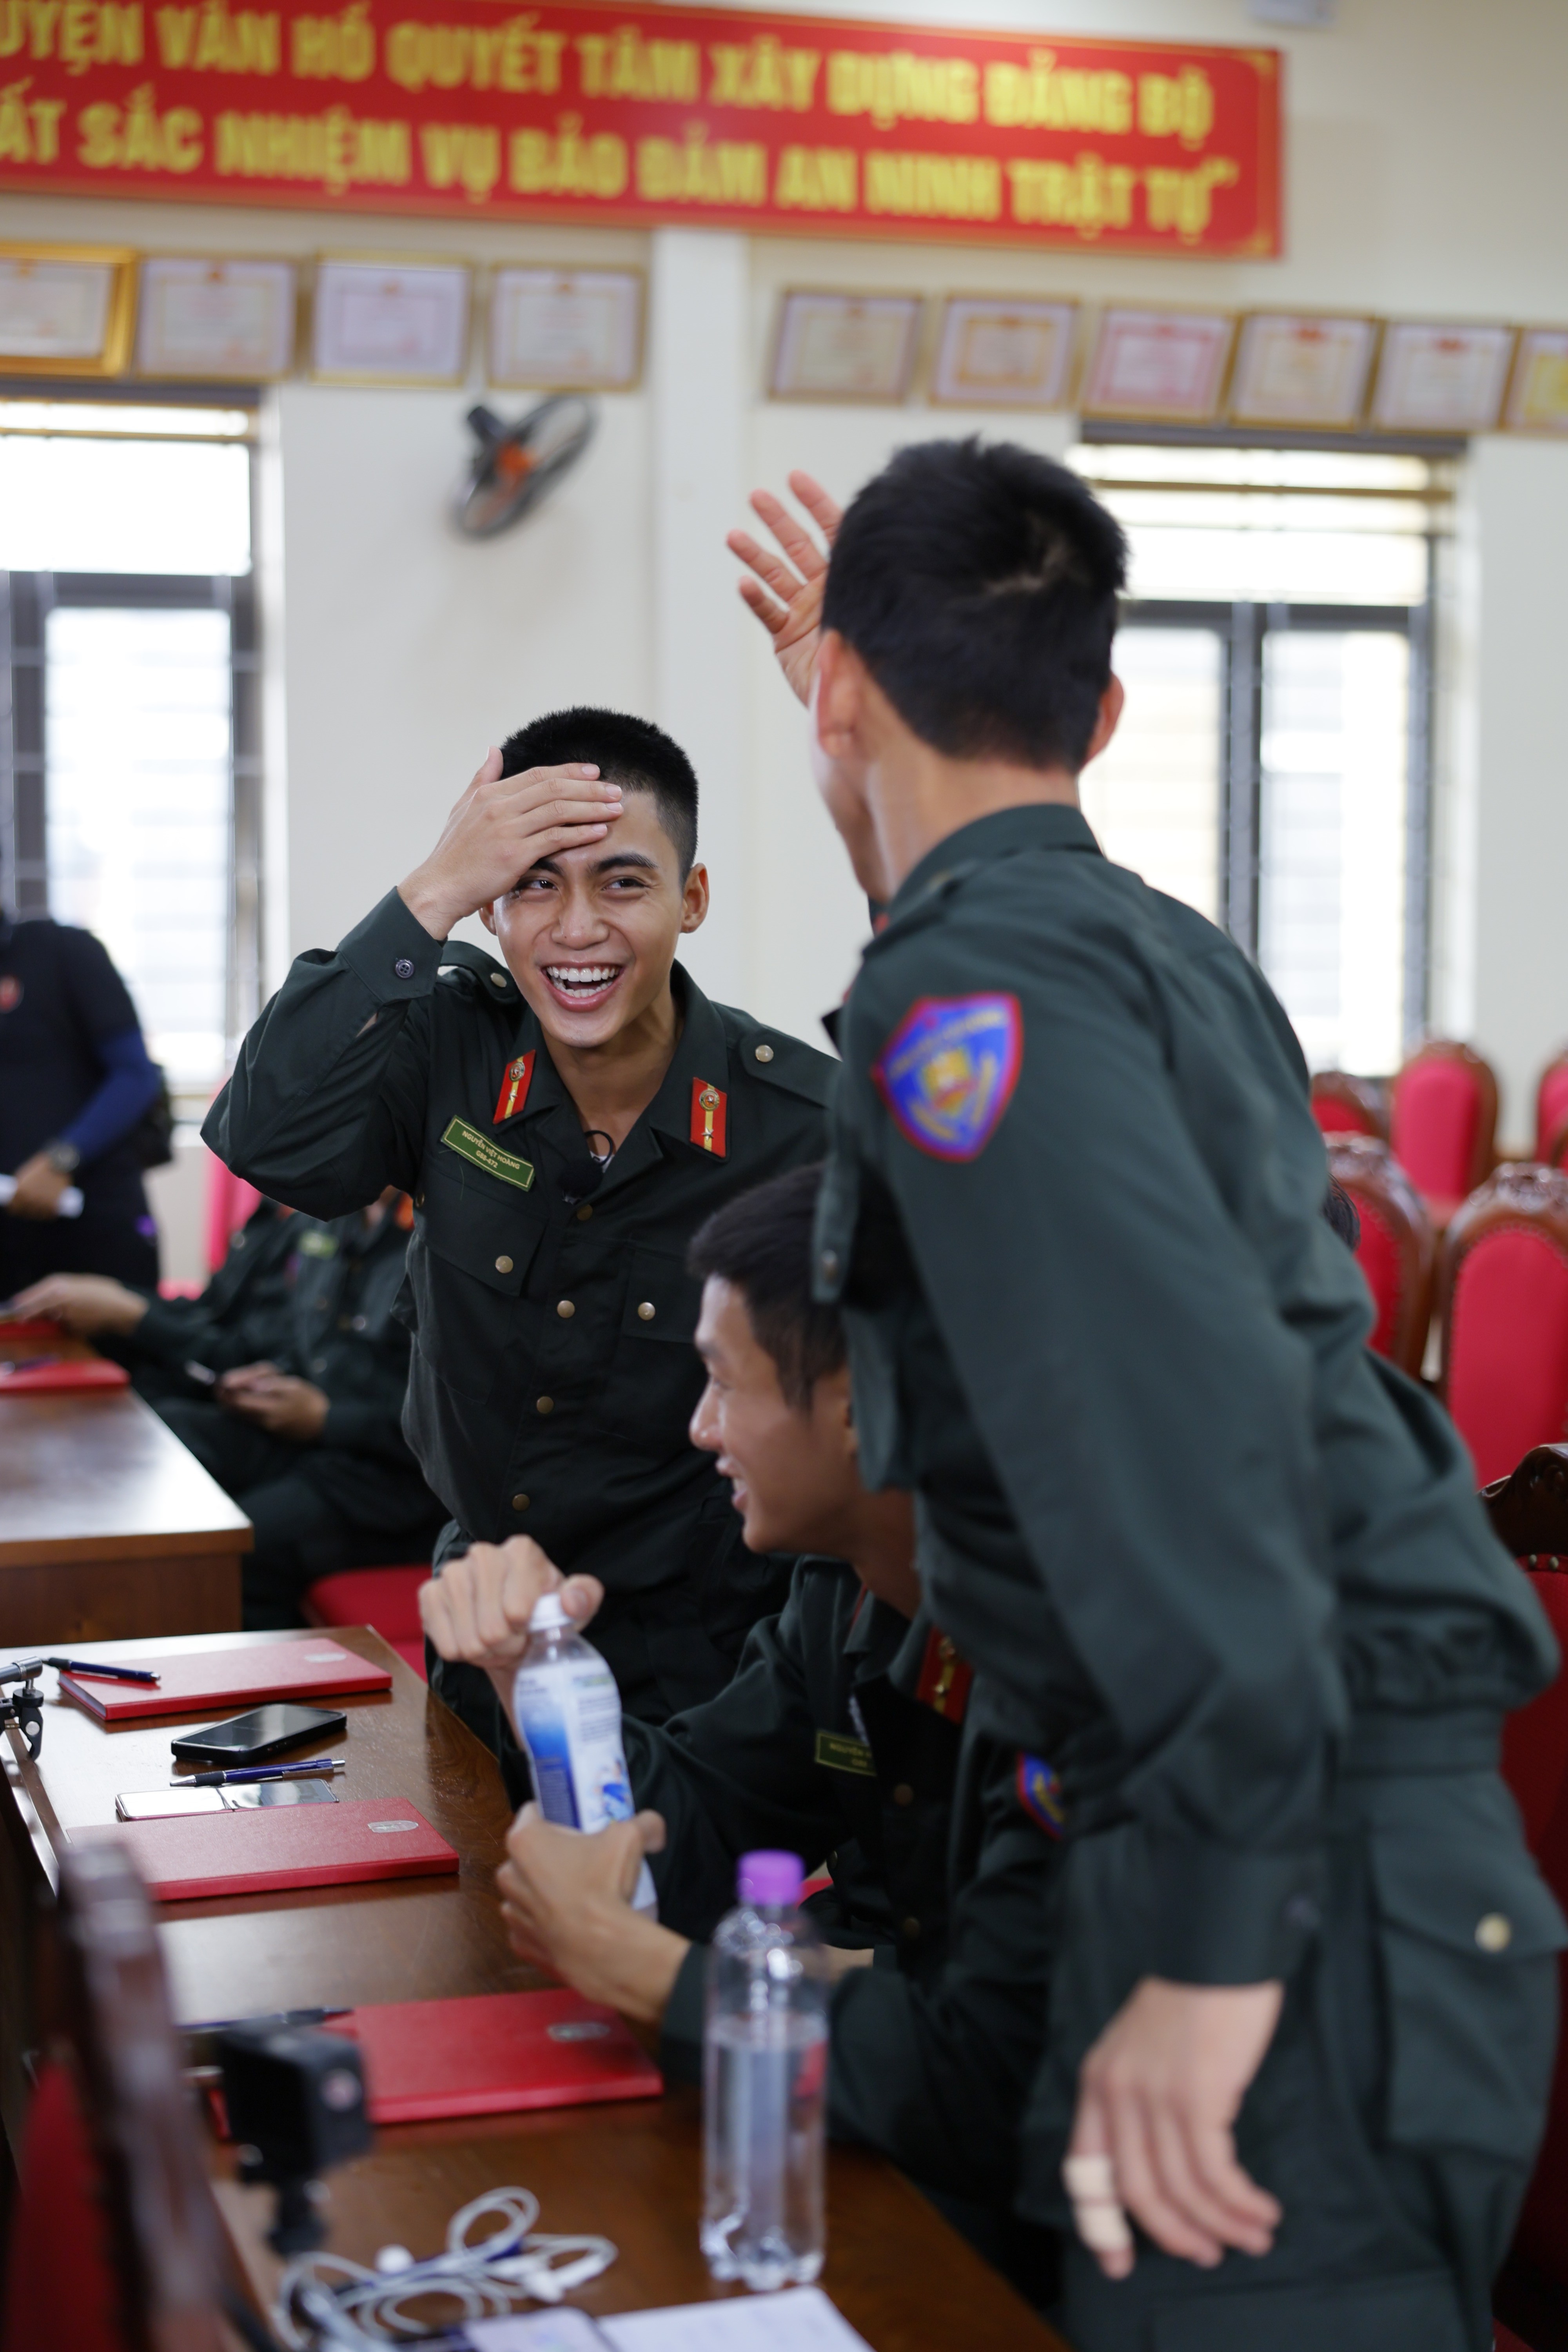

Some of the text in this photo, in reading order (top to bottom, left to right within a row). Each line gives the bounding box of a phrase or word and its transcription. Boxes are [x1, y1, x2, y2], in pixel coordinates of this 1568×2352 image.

[387, 16, 566, 93] QUYẾT
[577, 27, 699, 101] TÂM
[711, 36, 820, 110] XÂY
[828, 51, 980, 129] DỰNG
[983, 49, 1132, 133] ĐẢNG
[1138, 68, 1212, 148] BỘ
[79, 85, 202, 172] SẮC
[216, 107, 410, 195] NHIỆM
[421, 125, 499, 204] VỤ
[510, 116, 627, 197] BẢO
[776, 147, 857, 210] AN
[865, 152, 1001, 219] NINH
[1006, 154, 1136, 240] TRẬT
[462, 1131, 486, 1149] NGUYỄN
[486, 1147, 497, 1157] VIỆT
